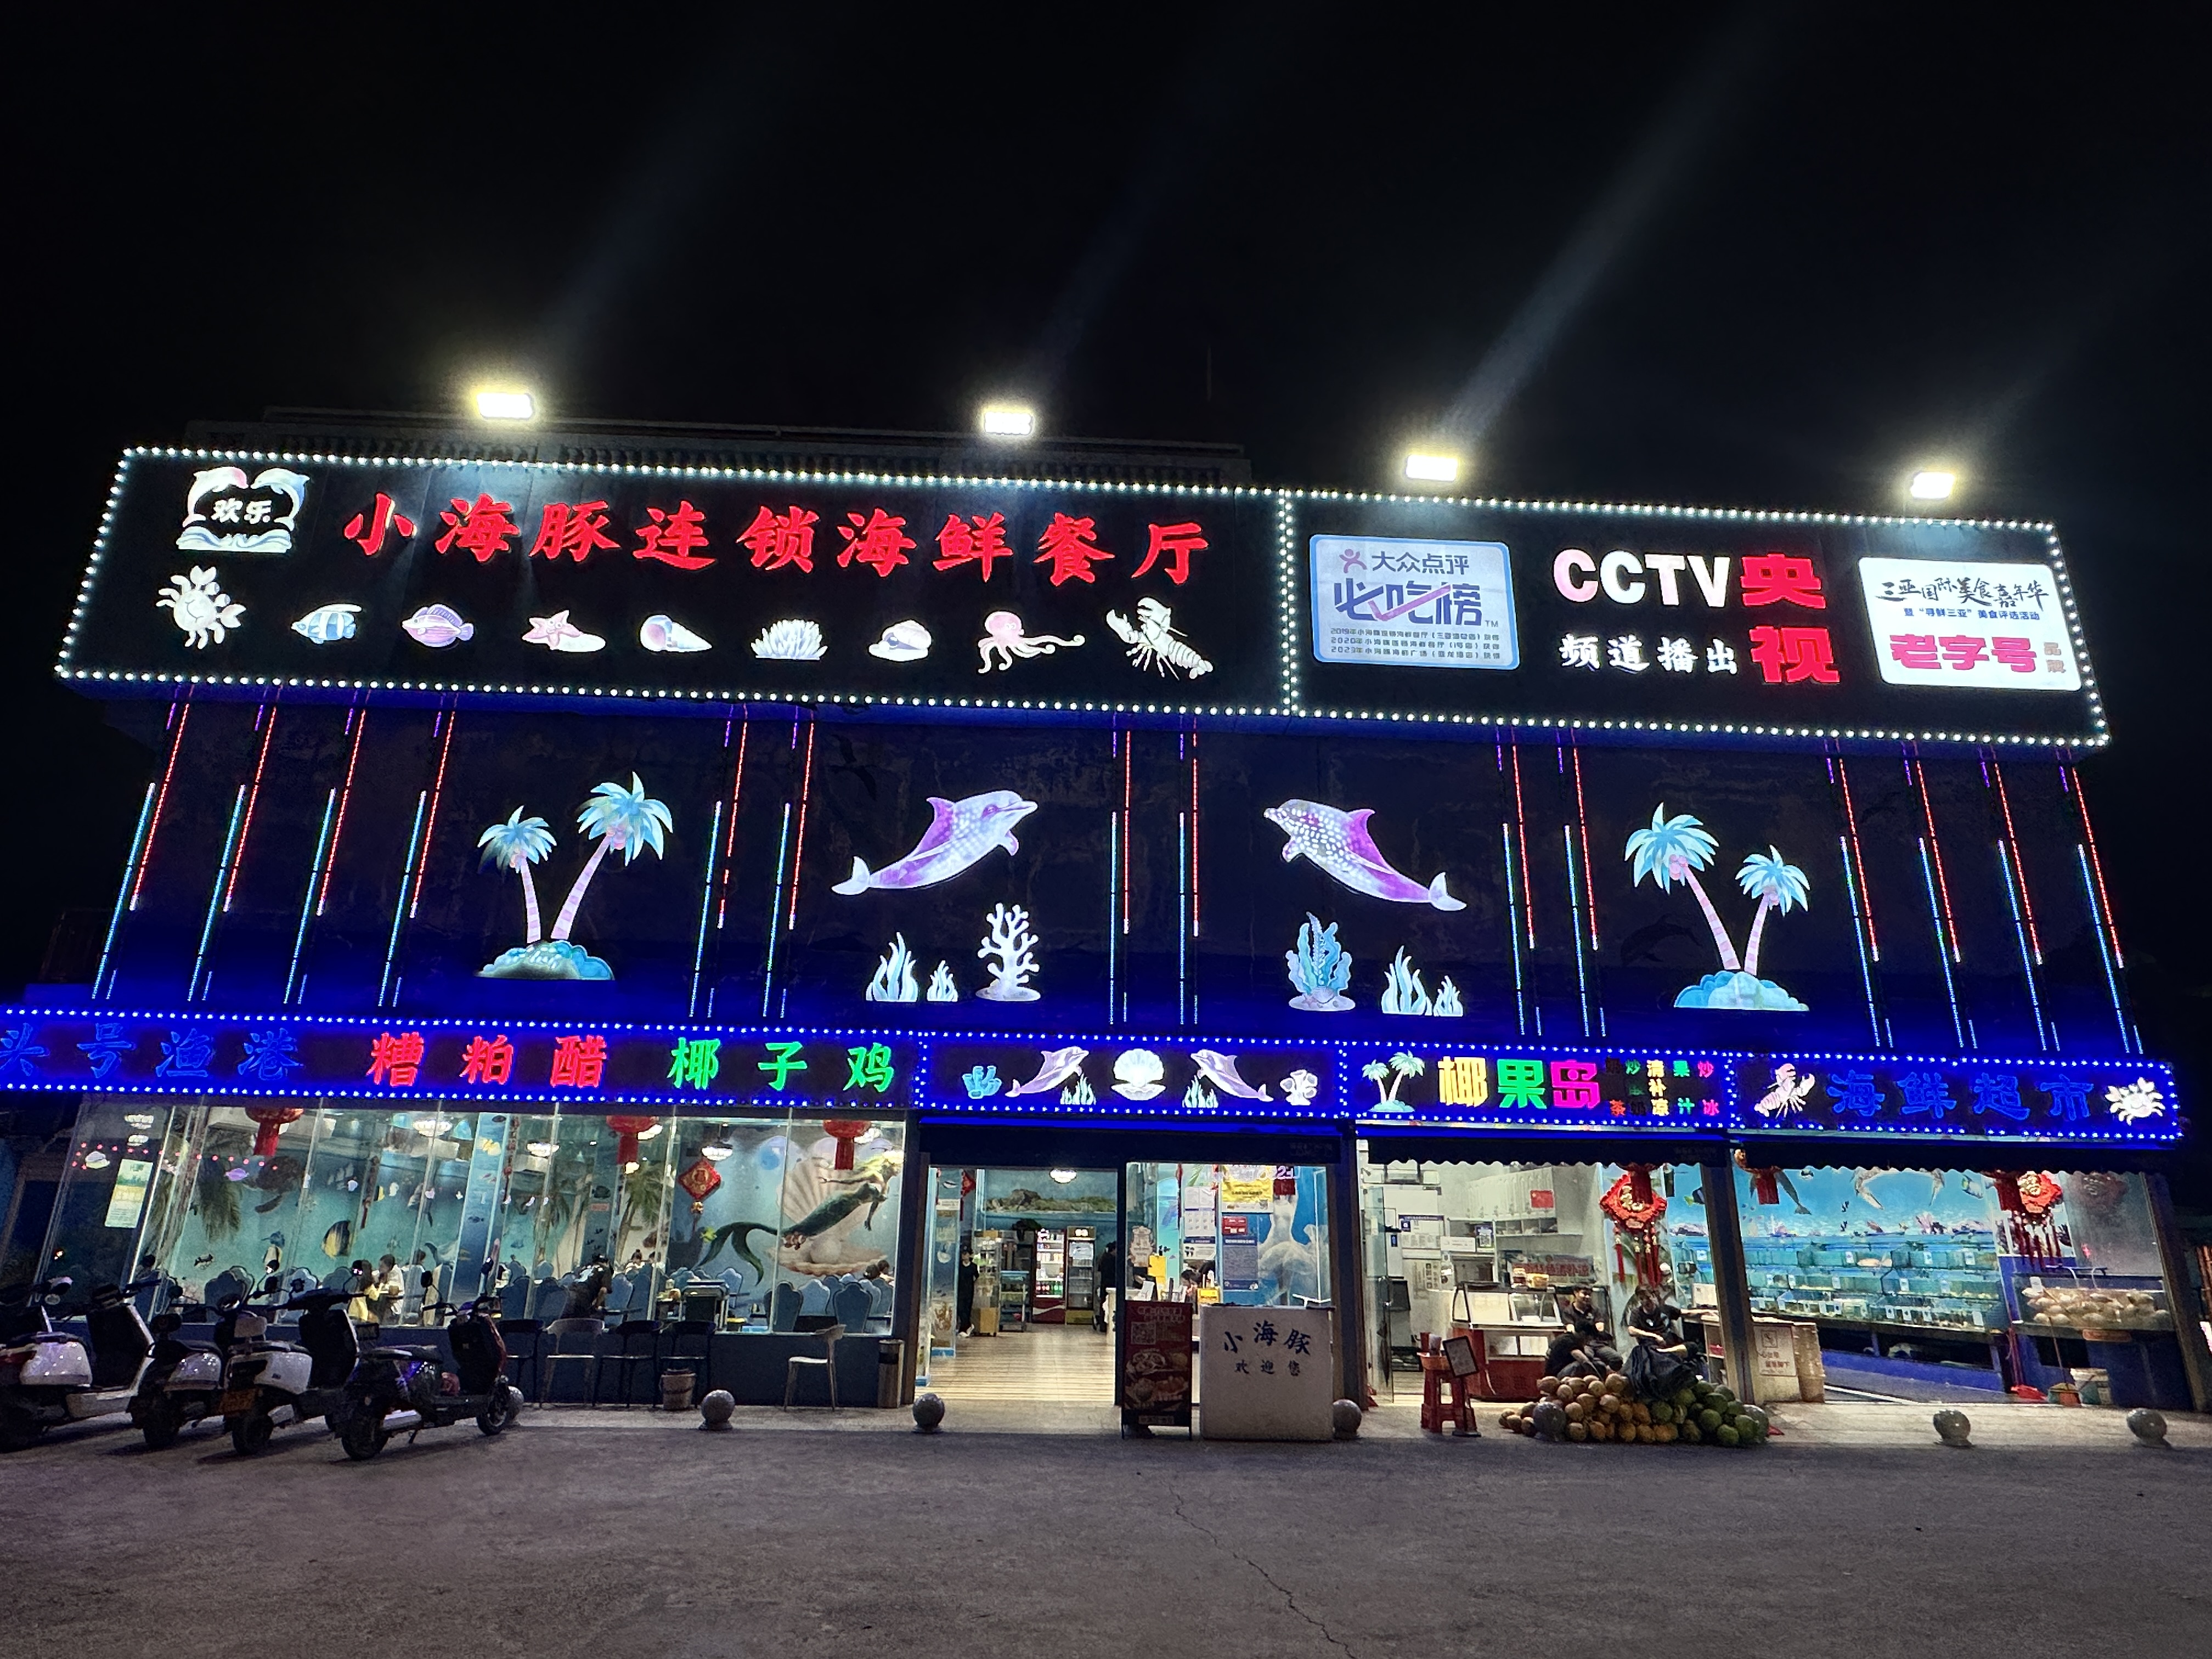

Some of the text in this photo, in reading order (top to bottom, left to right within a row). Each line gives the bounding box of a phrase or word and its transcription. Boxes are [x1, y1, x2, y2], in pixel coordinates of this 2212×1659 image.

[211, 498, 272, 524] 欢乐
[344, 493, 1208, 587] 小海豚连锁海鲜餐厅
[1372, 551, 1470, 575] 大众点评
[1553, 549, 1731, 608] CCTV
[1334, 578, 1482, 626] 必吃榜
[1876, 577, 2050, 611] 三亚国际美食嘉年华
[1740, 553, 1840, 683] 央视
[1559, 633, 1738, 675] 频道播出
[1890, 634, 2036, 673] 老字号
[366, 1031, 607, 1087] 糟粕醋
[667, 1037, 894, 1093] 椰子鸡
[1437, 1056, 1601, 1109] 椰果岛
[1826, 1070, 2094, 1121] 海鲜超市
[1223, 1319, 1312, 1356] 小海豚
[1234, 1358, 1302, 1378] 欢迎您
